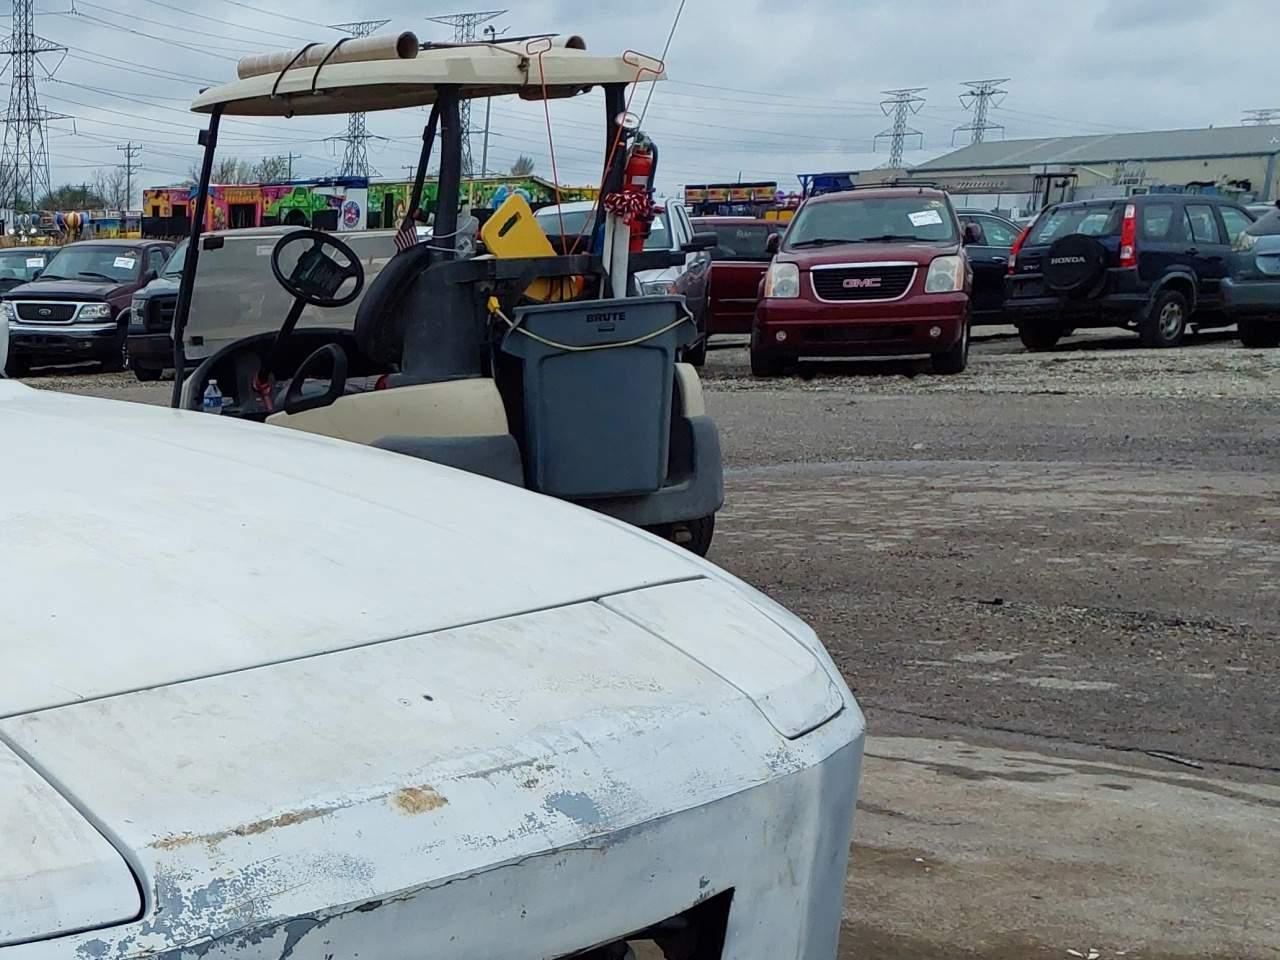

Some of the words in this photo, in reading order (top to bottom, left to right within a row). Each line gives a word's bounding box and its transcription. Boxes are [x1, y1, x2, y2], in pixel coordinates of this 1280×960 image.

[1051, 256, 1086, 265] HONDA
[842, 277, 882, 288] GMC
[586, 311, 626, 323] BRUTE
